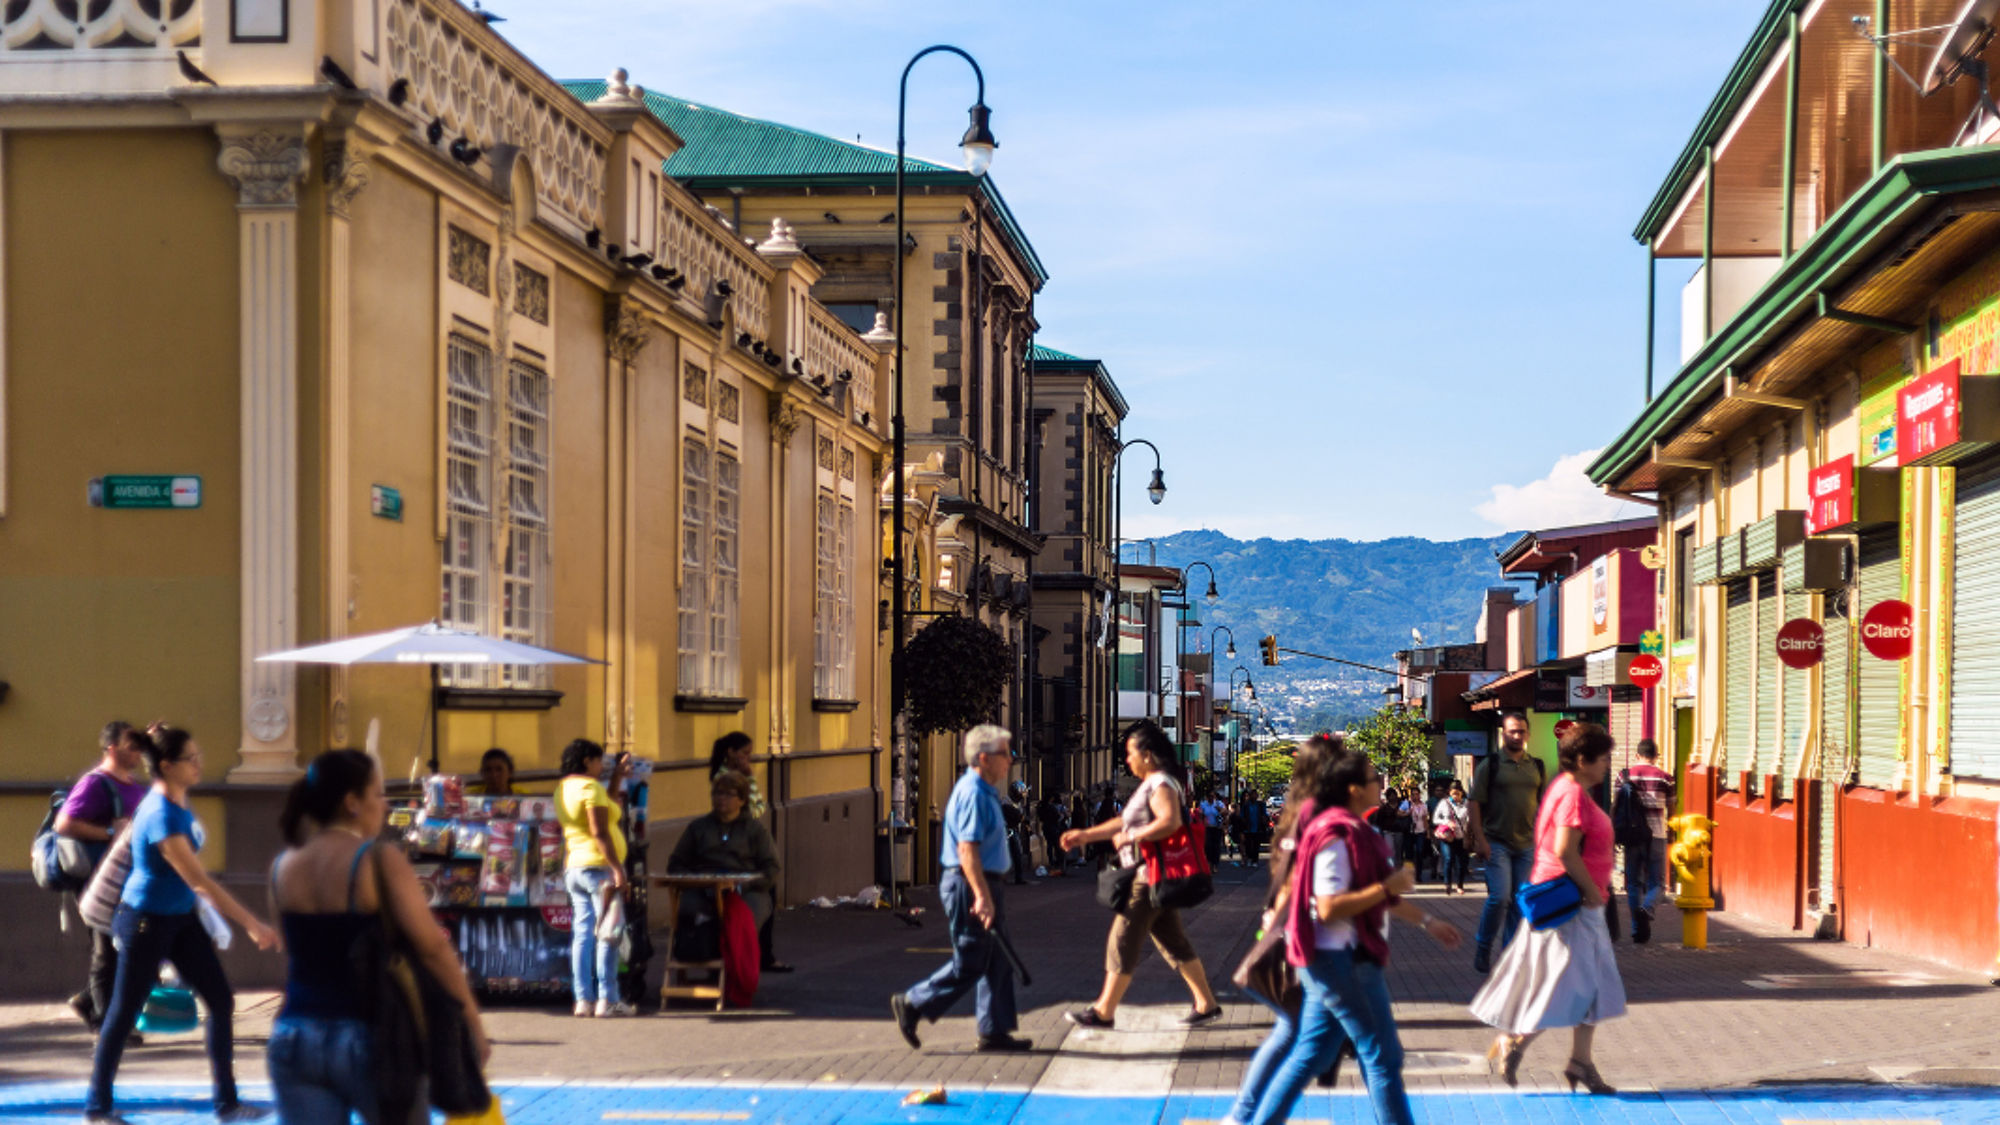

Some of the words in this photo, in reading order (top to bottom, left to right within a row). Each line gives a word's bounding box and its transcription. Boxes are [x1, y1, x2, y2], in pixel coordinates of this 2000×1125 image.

[113, 485, 160, 498] AVENIDA
[163, 486, 171, 497] 4
[1864, 619, 1912, 639] Claro
[1779, 636, 1819, 651] Claro
[1629, 665, 1658, 676] Claro
